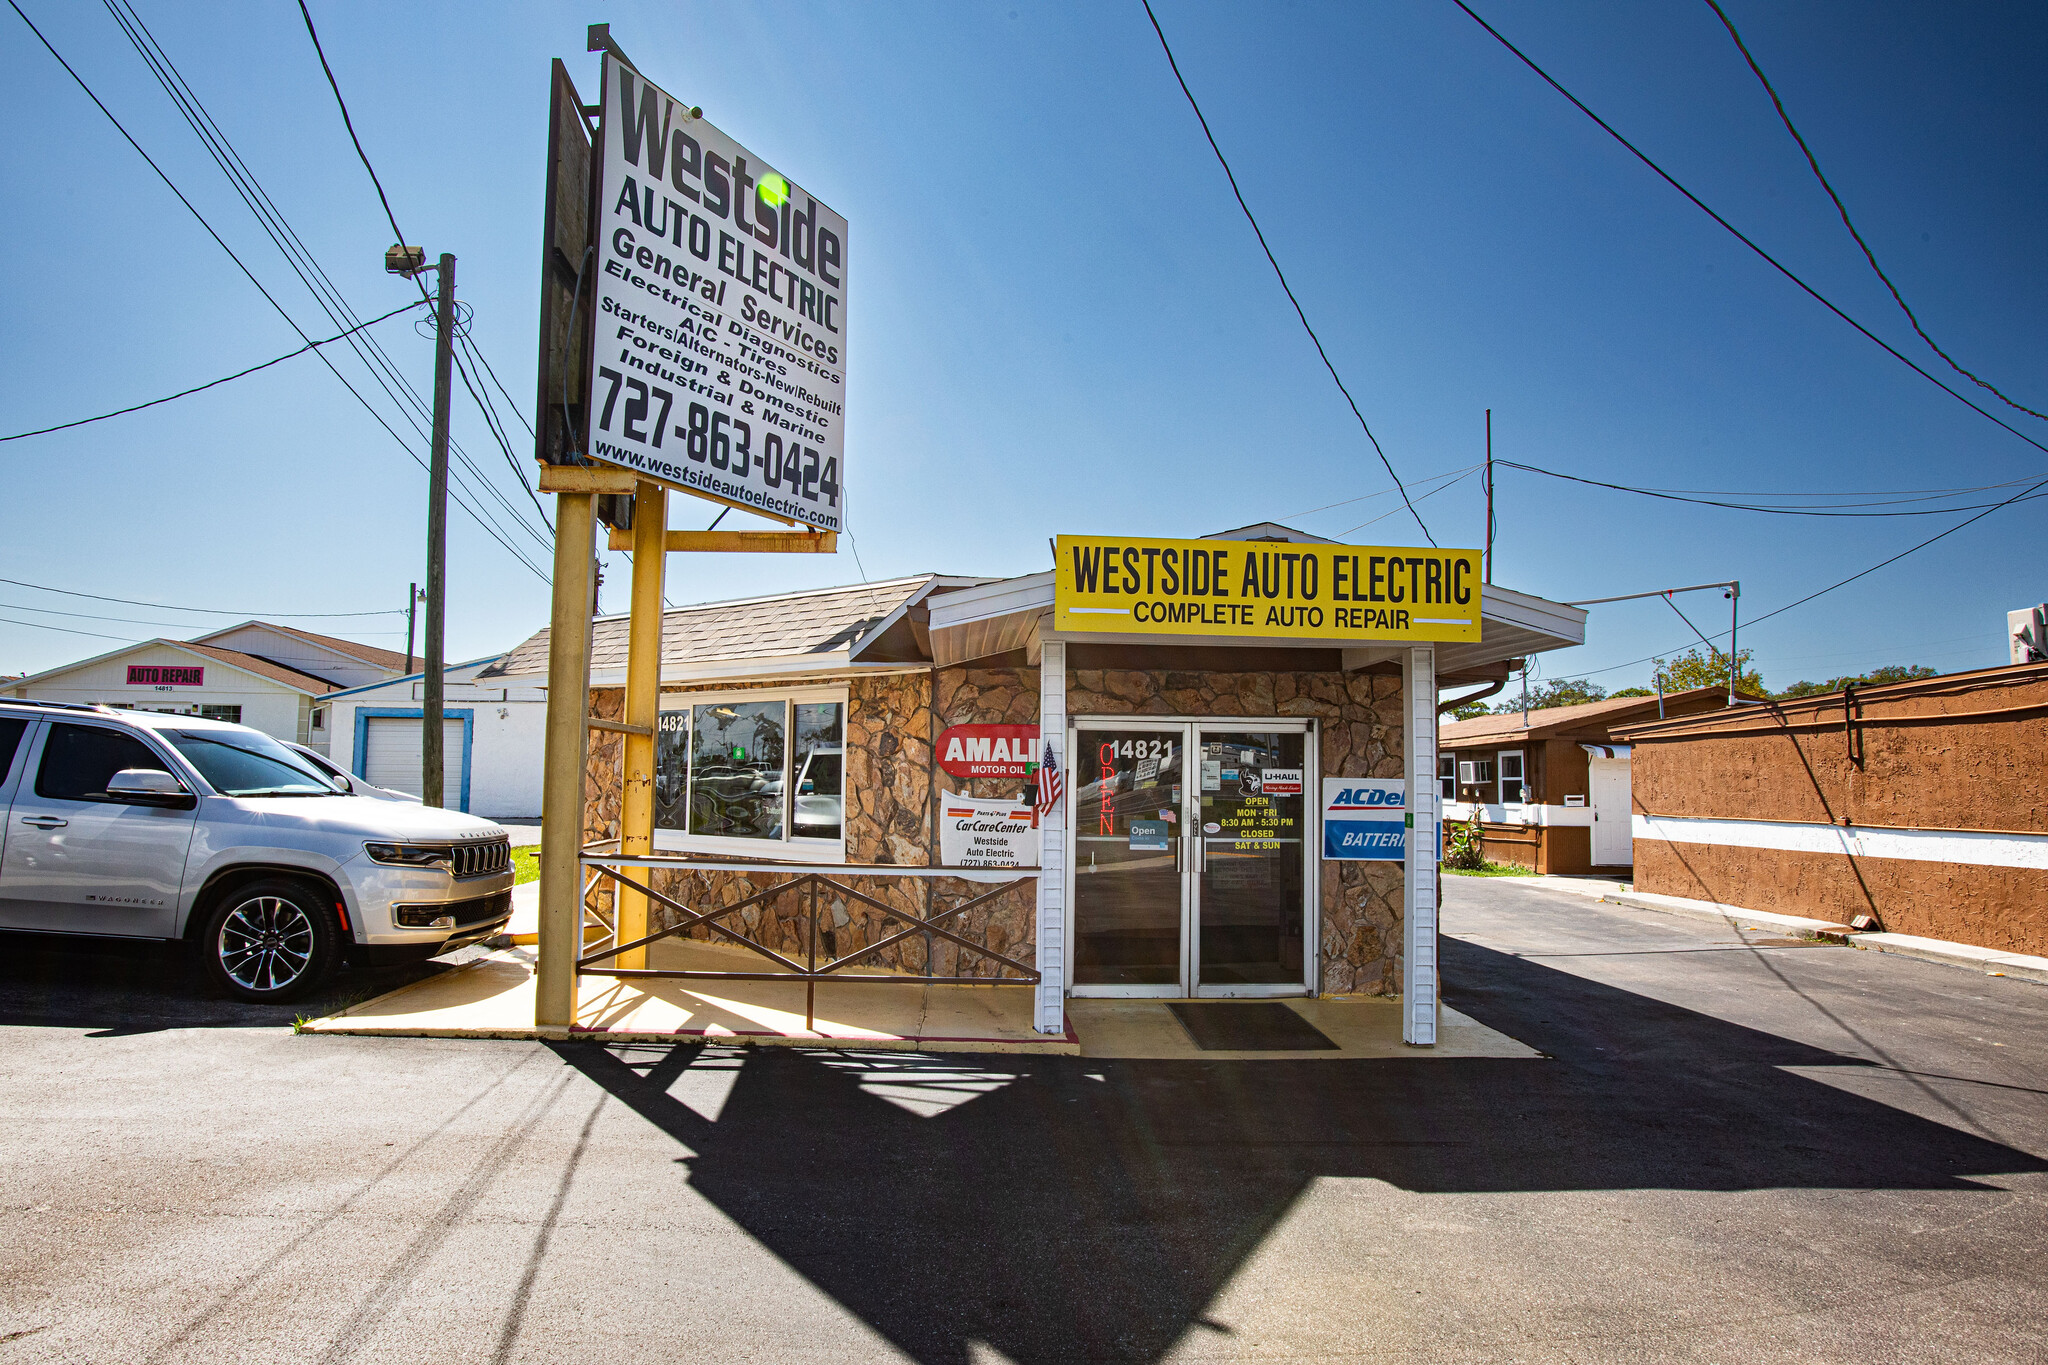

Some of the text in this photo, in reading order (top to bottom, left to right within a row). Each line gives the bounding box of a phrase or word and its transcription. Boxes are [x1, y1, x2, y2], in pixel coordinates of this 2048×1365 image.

[619, 65, 840, 289] Westside
[614, 175, 839, 334] AUTO ELECTRIC
[612, 228, 838, 364] General Services
[604, 258, 840, 384] Electrical Diagnostics
[738, 342, 787, 376] Tires
[616, 326, 829, 428] Foreign & Domestic
[620, 348, 826, 444] Industrial & Marine
[598, 366, 839, 508] 727-863-0424
[595, 440, 838, 528] www.westsideautoelectric.com
[1072, 546, 1471, 606] WESTSIDE AUTO ELECTRIC
[1134, 601, 1410, 630] COMPLETE AUTO REPAIR
[129, 668, 200, 683] AUTO REPAIR
[658, 716, 690, 732] 14821
[1110, 740, 1172, 758] 14821
[971, 766, 1006, 774] MOTOR
[1010, 766, 1026, 774] OIL
[1100, 743, 1115, 836] OPEN
[1132, 826, 1156, 836] Open
[1240, 818, 1254, 826] AM
[1261, 818, 1278, 826] 5:30
[1281, 818, 1293, 826] PM
[1240, 830, 1274, 838] CLOSED
[966, 848, 1014, 858] Auto Electric
[974, 836, 1008, 846] Westside
[1235, 842, 1280, 850] SAT & SUN
[1342, 832, 1405, 847] BATTERI
